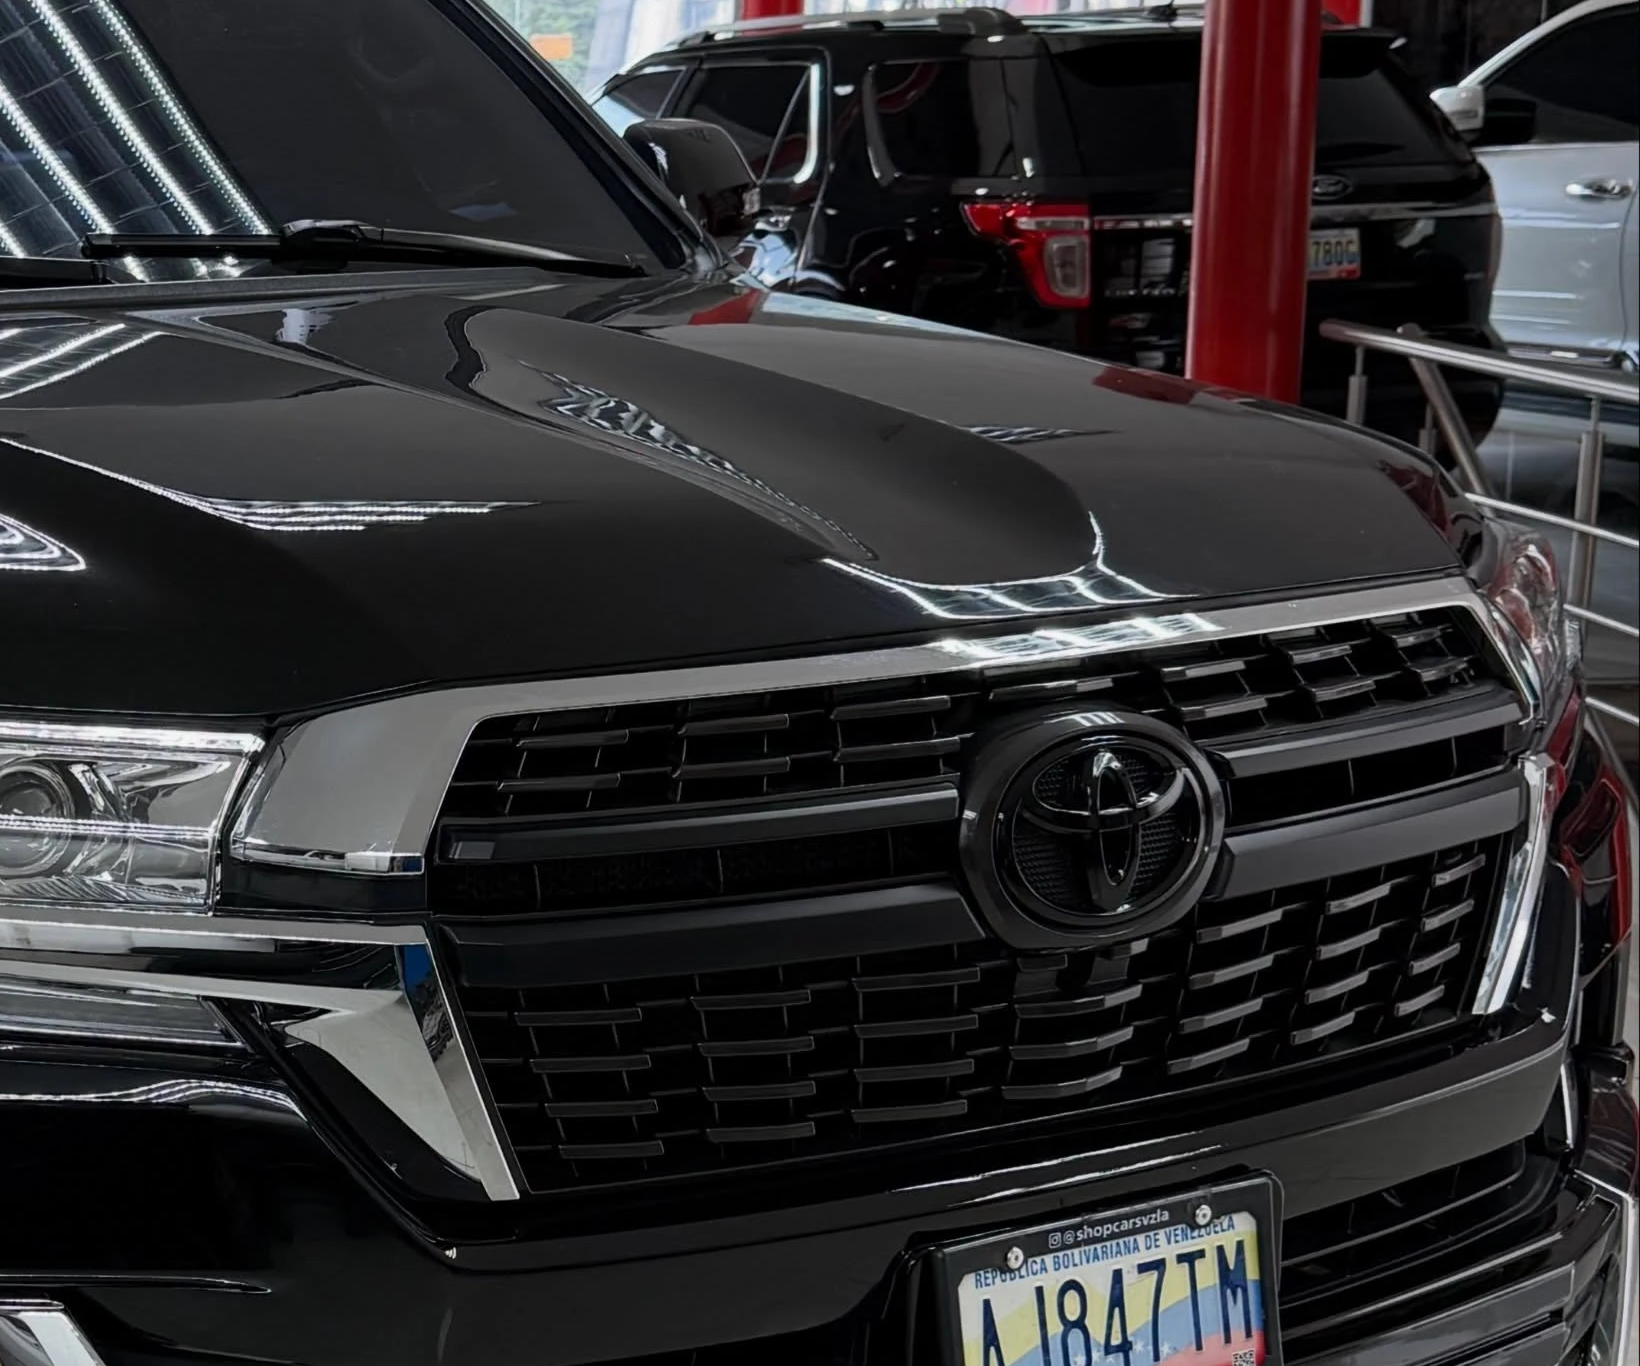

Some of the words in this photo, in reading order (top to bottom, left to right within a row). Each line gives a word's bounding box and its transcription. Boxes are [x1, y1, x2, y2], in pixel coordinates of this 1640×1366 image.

[1063, 1208, 1170, 1244] @shopcarsvzla
[1053, 1239, 1141, 1272] BOLIVARIANA
[1145, 1233, 1161, 1251] DE
